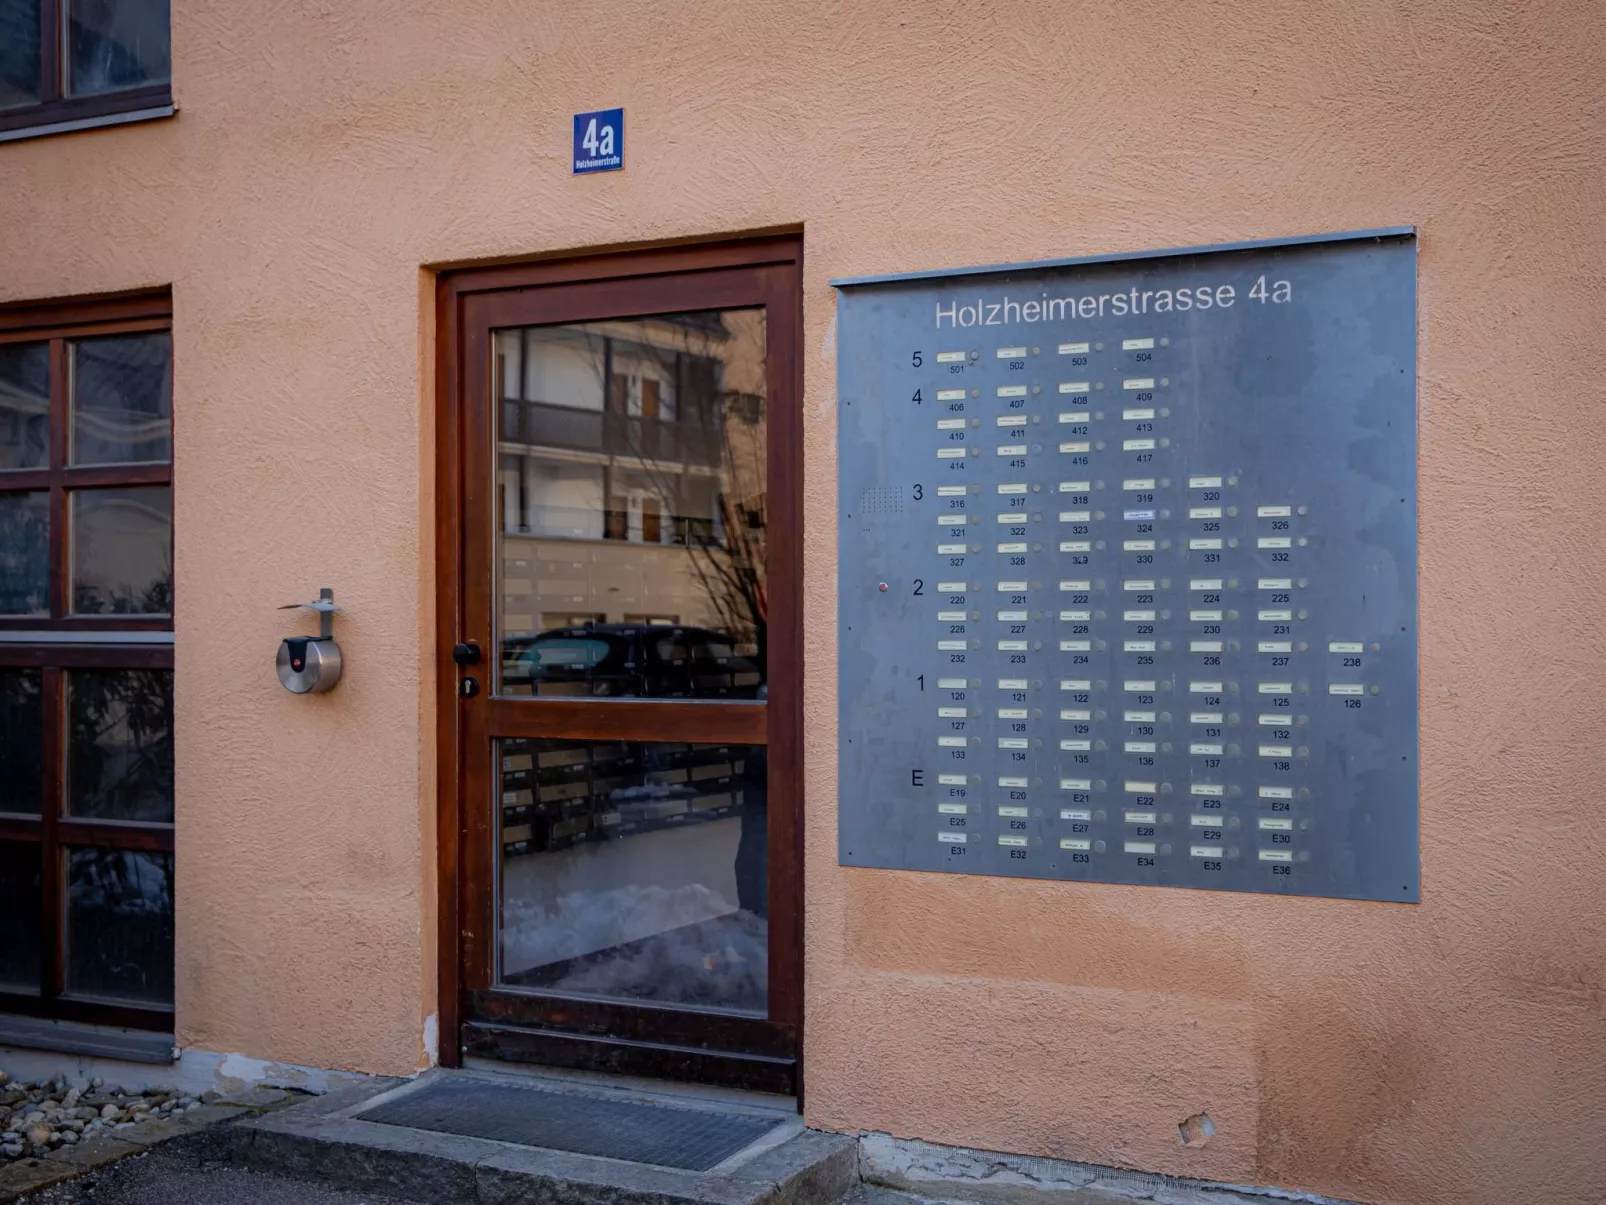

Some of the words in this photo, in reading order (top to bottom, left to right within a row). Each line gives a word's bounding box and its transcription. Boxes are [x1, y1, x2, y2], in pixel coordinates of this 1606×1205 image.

[582, 118, 614, 157] 4a
[576, 156, 620, 169] Holzheimerstraße
[935, 284, 1235, 328] Holzheimerstrasse
[1248, 275, 1292, 304] 4a
[912, 351, 923, 368] 5
[1071, 357, 1088, 366] 503
[1136, 353, 1152, 362] 504
[950, 365, 964, 374] 501
[1009, 361, 1025, 370] 502
[912, 388, 923, 405] 4
[1071, 396, 1088, 405] 408
[1136, 393, 1153, 401] 409
[949, 403, 964, 412] 406
[1009, 400, 1025, 409] 407
[1071, 426, 1088, 435] 412
[1136, 424, 1153, 432] 413
[949, 432, 964, 441] 410
[1010, 429, 1025, 438] 411
[1072, 457, 1088, 465] 416
[1136, 454, 1153, 463] 417
[950, 462, 965, 470] 414
[1010, 459, 1026, 468] 415
[912, 484, 924, 501] 3
[1203, 492, 1220, 501] 320
[1010, 498, 1025, 506] 317
[1072, 496, 1088, 504] 318
[1136, 494, 1153, 503] 319
[950, 500, 965, 508] 316
[1072, 526, 1088, 534] 323
[1136, 524, 1153, 533] 324
[1203, 523, 1220, 531] 325
[1271, 521, 1289, 530] 326
[951, 528, 965, 537] 321
[1010, 527, 1026, 536] 322
[949, 558, 965, 566] 327
[1010, 557, 1026, 566] 328
[1136, 555, 1153, 564] 330
[1204, 554, 1220, 563] 331
[1271, 553, 1289, 562] 332
[913, 579, 924, 596] 2
[950, 596, 965, 604] 220
[1011, 596, 1026, 604] 221
[1072, 595, 1088, 604] 222
[1137, 595, 1153, 604] 223
[1203, 594, 1220, 603] 224
[1271, 594, 1289, 603] 225
[950, 625, 965, 634] 226
[1010, 625, 1026, 634] 227
[1073, 625, 1089, 634] 228
[1137, 625, 1154, 634] 229
[1203, 625, 1221, 634] 230
[1273, 625, 1290, 634] 231
[950, 655, 965, 663] 232
[1010, 655, 1026, 664] 233
[1073, 655, 1089, 664] 234
[1137, 656, 1154, 665] 235
[1203, 656, 1221, 665] 236
[1272, 657, 1289, 666] 237
[1343, 658, 1361, 667] 238
[917, 674, 924, 691] 1
[951, 692, 965, 700] 120
[1012, 693, 1026, 702] 121
[1073, 694, 1088, 703] 122
[1138, 696, 1154, 704] 123
[1204, 697, 1220, 705] 124
[1272, 698, 1290, 707] 125
[1344, 699, 1362, 708] 126
[951, 722, 965, 730] 127
[1011, 723, 1026, 732] 128
[1073, 725, 1089, 733] 129
[1138, 727, 1154, 736] 130
[1205, 728, 1221, 737] 131
[1273, 730, 1290, 739] 132
[951, 751, 965, 759] 133
[1011, 753, 1026, 761] 134
[1074, 755, 1089, 763] 135
[1138, 757, 1154, 766] 136
[1204, 759, 1220, 768] 137
[1273, 762, 1290, 771] 138
[912, 770, 924, 787] E
[949, 789, 966, 797] E19
[1010, 791, 1026, 800] E20
[1073, 794, 1089, 803] E21
[1136, 797, 1154, 806] E22
[1203, 800, 1221, 809] E23
[1272, 803, 1290, 812] E24
[949, 818, 966, 827] E25
[1010, 821, 1026, 830] E26
[1072, 824, 1089, 833] E27
[1136, 827, 1154, 836] E28
[1203, 831, 1221, 840] E29
[1272, 834, 1290, 844] E30
[951, 847, 966, 856] E31
[1010, 850, 1027, 859] E32
[1073, 854, 1090, 863] E33
[1137, 858, 1154, 867] E34
[1204, 862, 1222, 871] E35
[1272, 866, 1291, 875] E36
